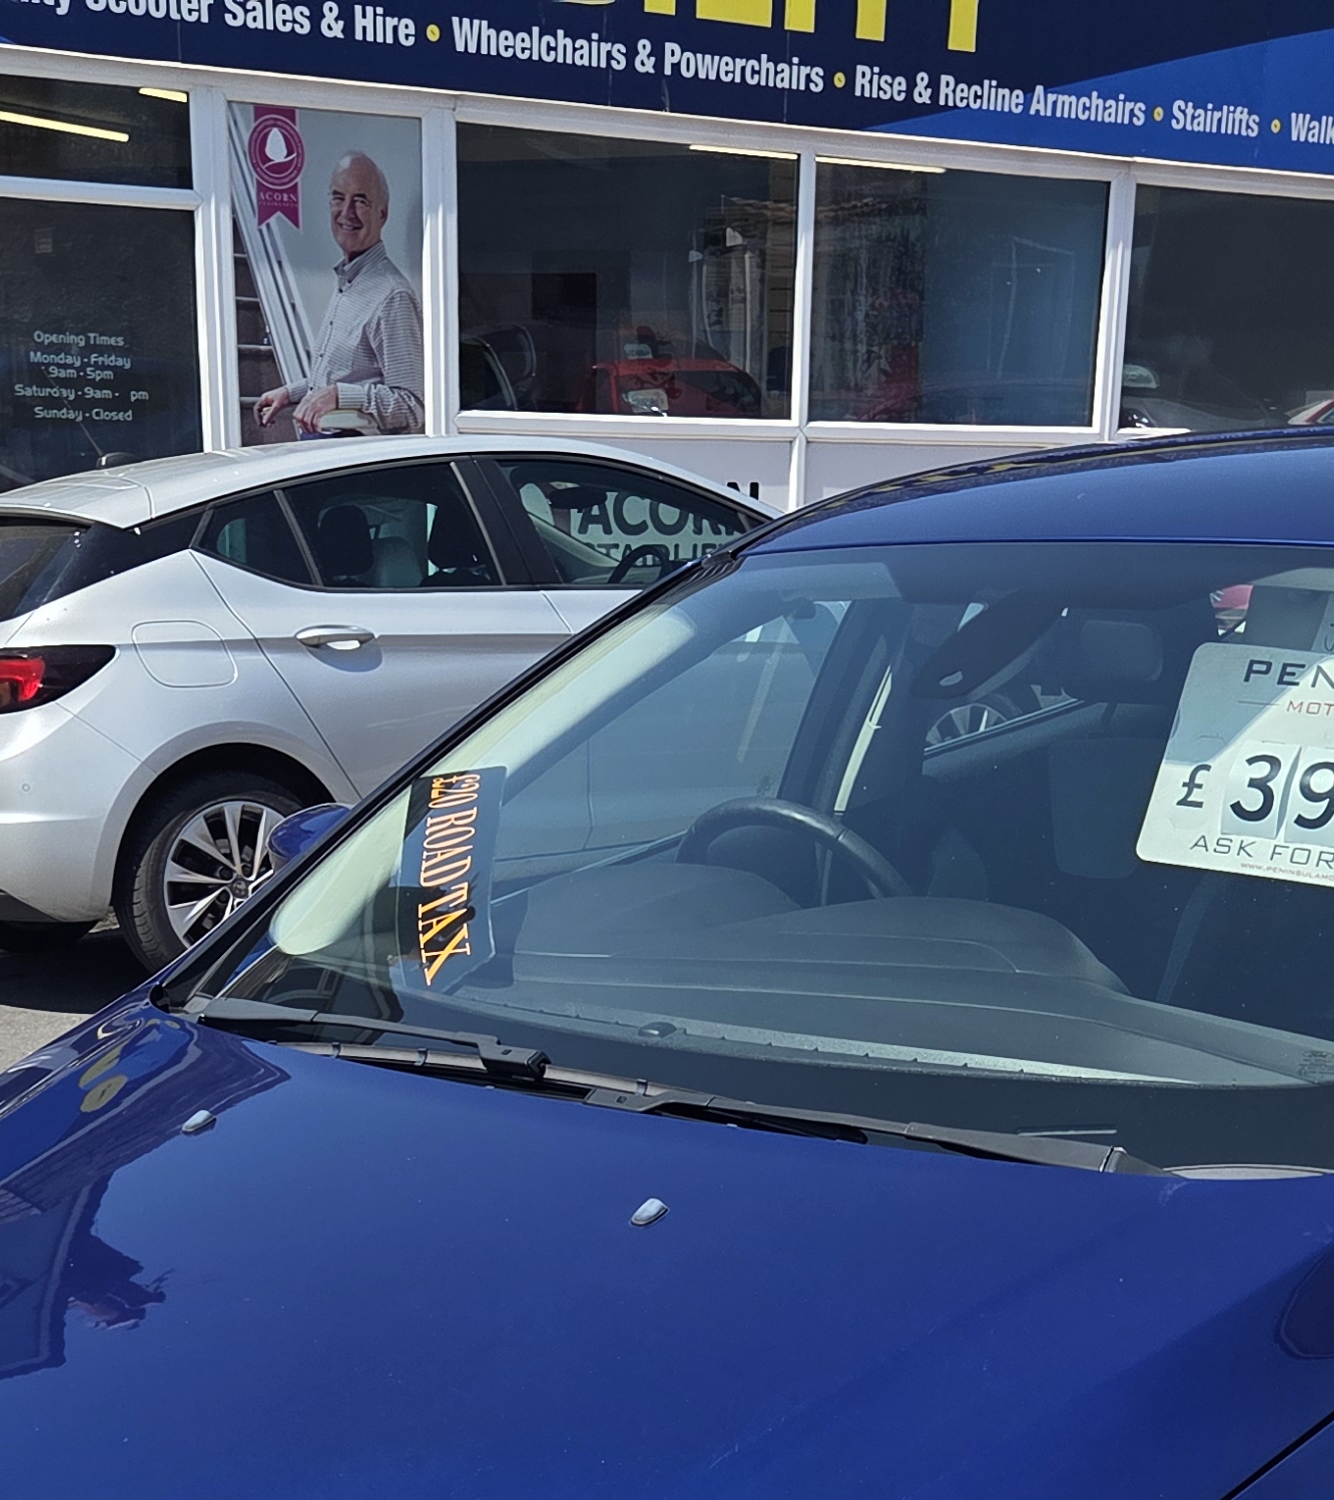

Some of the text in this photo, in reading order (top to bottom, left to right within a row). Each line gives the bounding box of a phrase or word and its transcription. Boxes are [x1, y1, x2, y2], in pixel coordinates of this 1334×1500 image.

[223, 0, 312, 35] Sales
[320, 5, 346, 38] &
[353, 2, 417, 47] Hire
[451, 16, 627, 71] Wheelchairs
[634, 38, 656, 74] &
[665, 41, 824, 93] Powerchairs
[854, 64, 908, 102] Rise
[913, 71, 932, 104] &
[938, 74, 1025, 114] Recline
[1029, 84, 1147, 127] Armchairs
[1170, 99, 1260, 138] Stairlifts
[33, 330, 125, 347] Opening Times
[29, 351, 81, 368] Monday
[90, 353, 132, 369] Friday
[48, 366, 77, 379] 9am
[86, 367, 114, 381] 5pm
[14, 384, 75, 400] Saturday
[84, 386, 113, 399] 9am
[130, 390, 149, 402] pm
[34, 406, 83, 422] Sunday
[92, 408, 133, 421] Closed
[1190, 834, 1255, 859] ASK
[418, 773, 481, 986] £20 ROAD TAX
